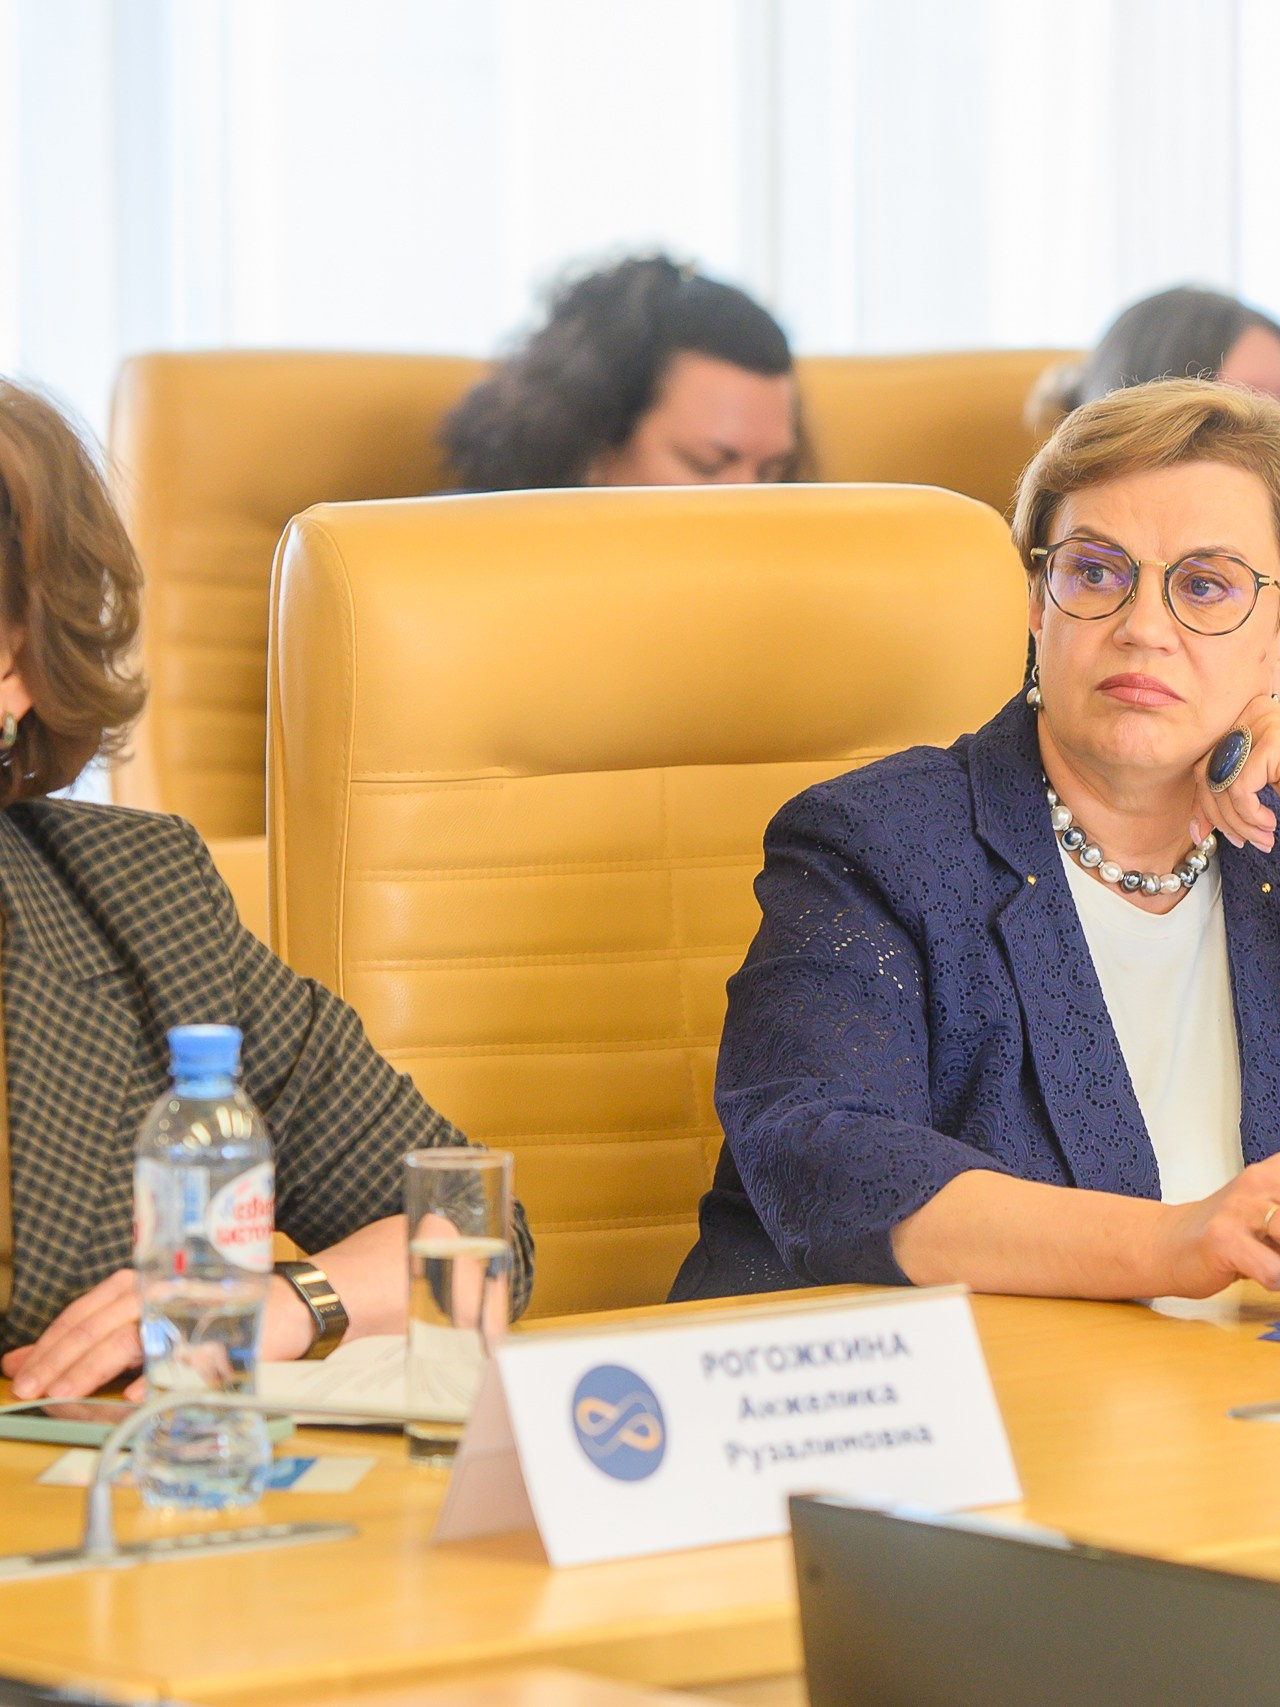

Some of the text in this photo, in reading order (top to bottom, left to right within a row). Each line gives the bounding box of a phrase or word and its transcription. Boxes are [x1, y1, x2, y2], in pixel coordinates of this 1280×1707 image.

[702, 1332, 912, 1380] РОГОЖКИНА
[739, 1383, 900, 1420] Анжелика
[724, 1424, 934, 1473] Рузалимовна
